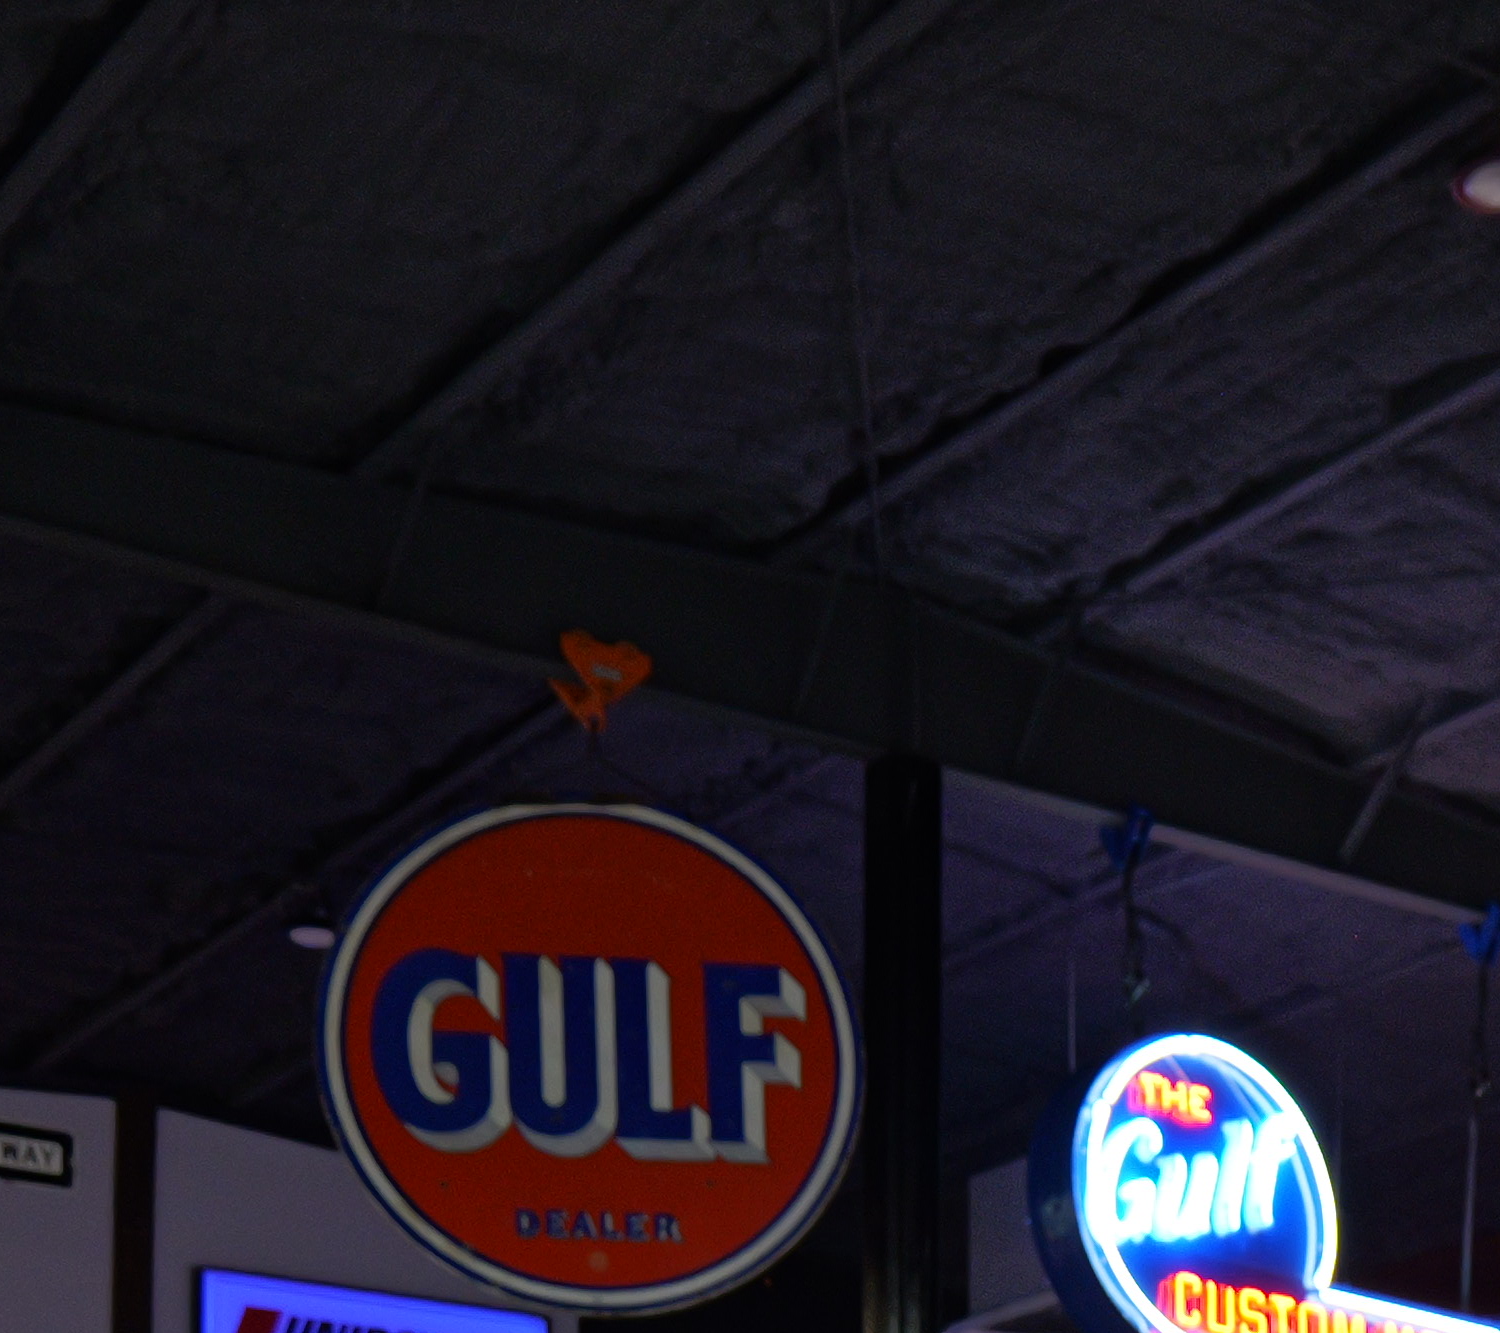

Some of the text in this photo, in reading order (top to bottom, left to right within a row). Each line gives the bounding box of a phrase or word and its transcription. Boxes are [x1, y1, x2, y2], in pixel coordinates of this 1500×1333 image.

[369, 947, 808, 1164] GULF
[1134, 1071, 1213, 1126] THE
[0, 1137, 60, 1173] WAY
[1101, 1109, 1301, 1244] Gulf
[514, 1207, 683, 1244] DEALER
